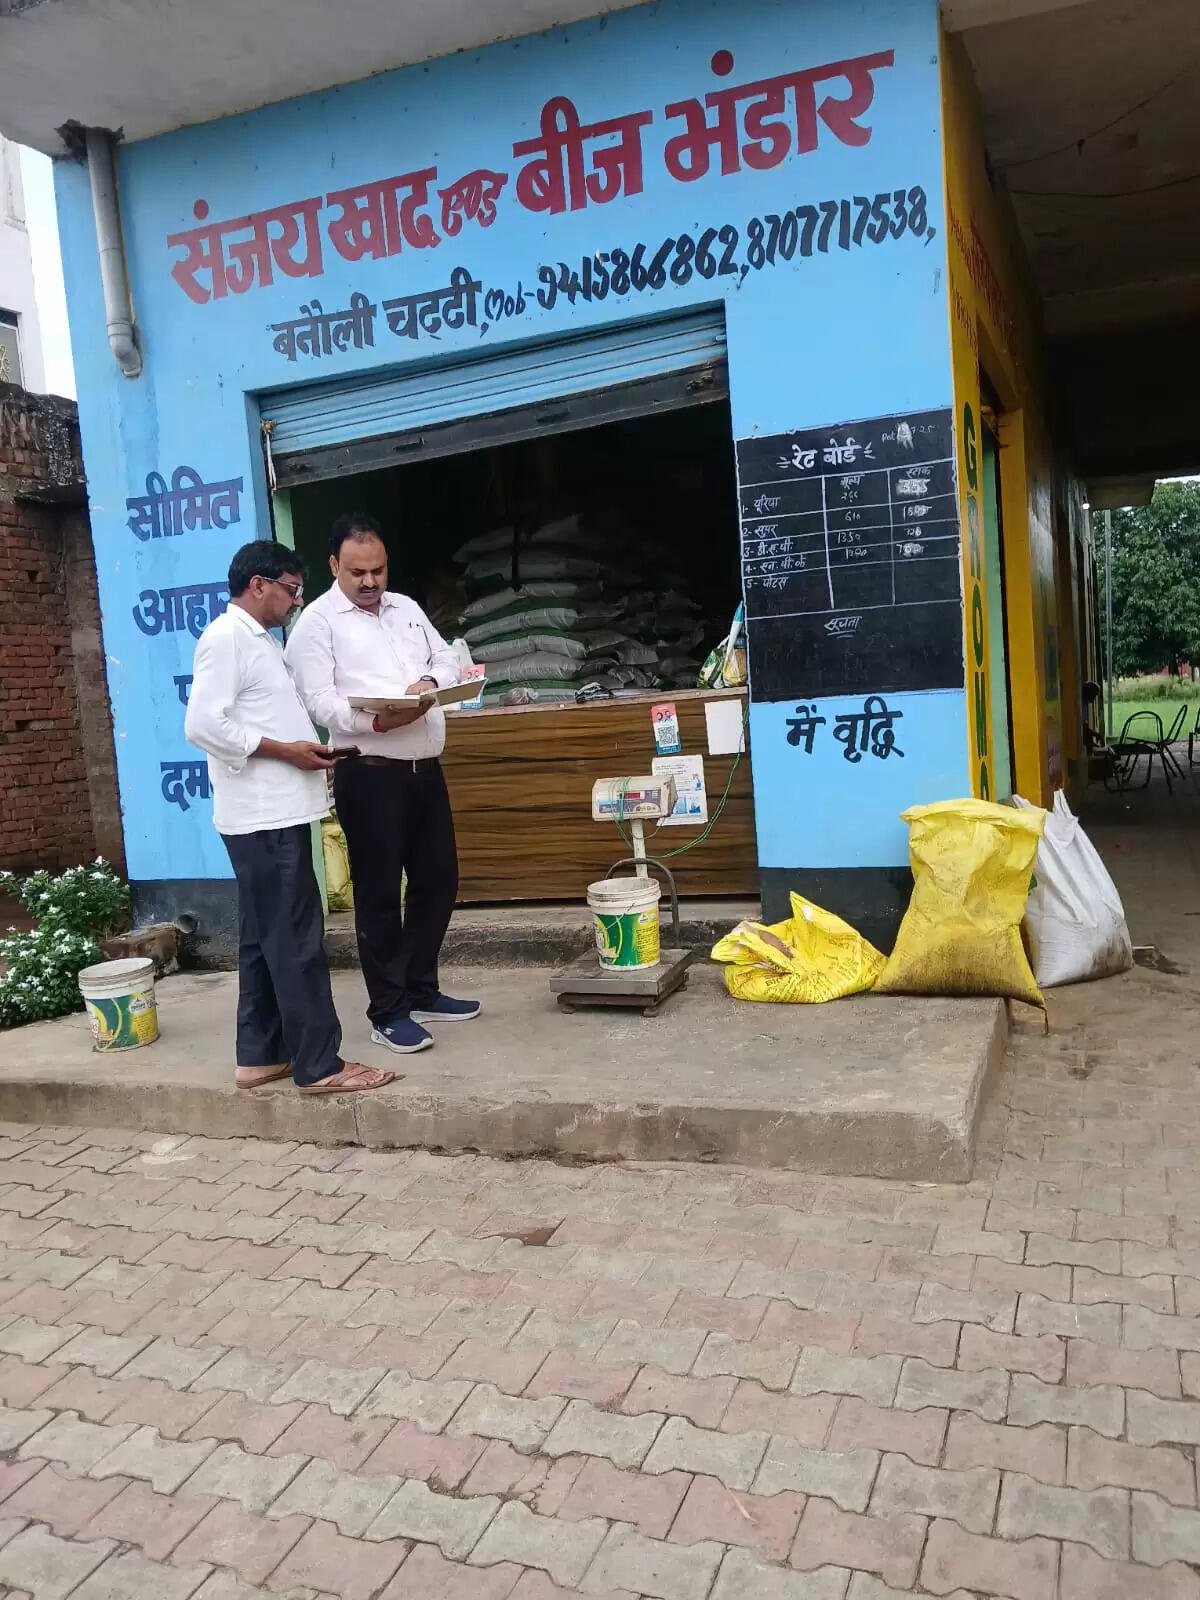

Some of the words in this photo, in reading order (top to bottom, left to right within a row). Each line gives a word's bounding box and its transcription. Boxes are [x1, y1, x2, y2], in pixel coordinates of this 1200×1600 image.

[167, 198, 325, 305] संजय
[512, 95, 653, 215] बीज
[664, 49, 894, 182] भंडार
[791, 443, 818, 470] रेट
[823, 437, 862, 466] बोर्ड
[126, 465, 244, 541] सीमित
[754, 494, 781, 514] यूरिया
[785, 704, 827, 754] में
[832, 695, 905, 763] वृद्धि
